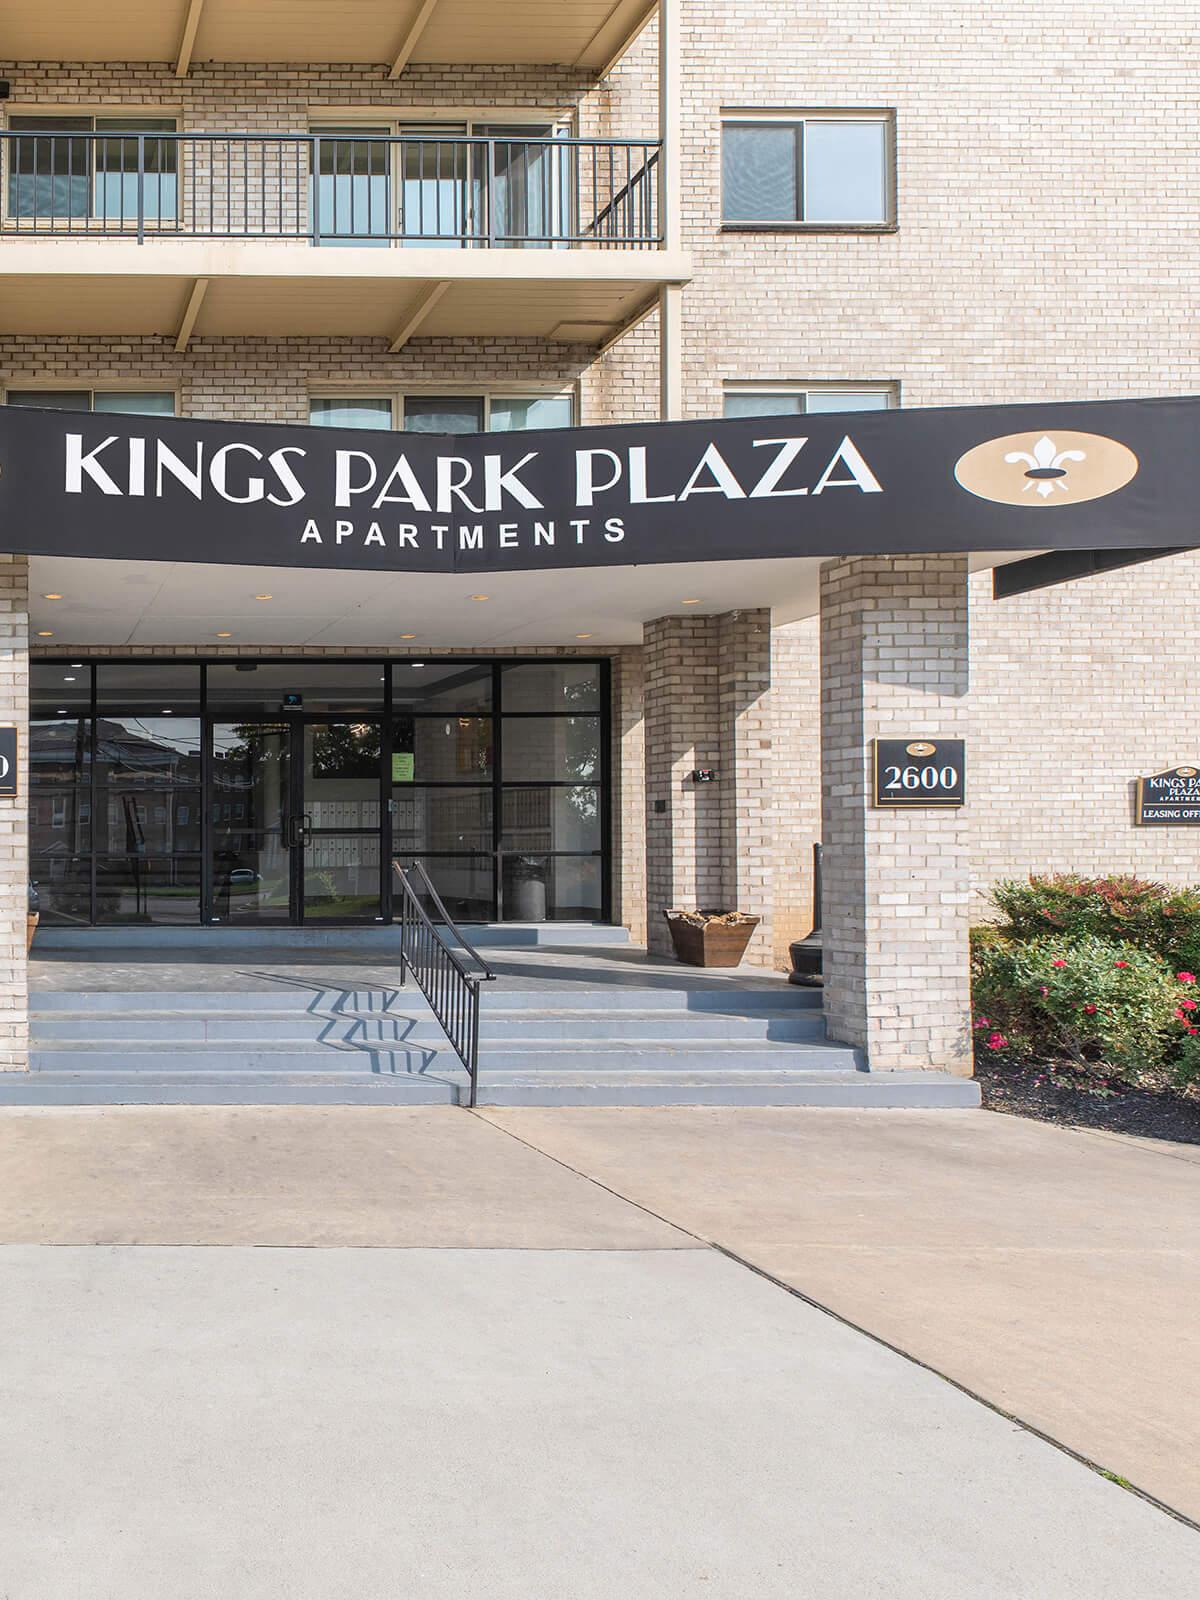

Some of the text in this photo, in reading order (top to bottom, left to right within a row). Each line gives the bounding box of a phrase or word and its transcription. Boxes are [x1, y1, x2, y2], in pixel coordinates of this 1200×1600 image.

[65, 433, 884, 514] KINGS PARK PLAZA
[300, 517, 625, 550] APARTMENTS
[884, 766, 958, 790] 2600
[1150, 778, 1186, 788] KINGS
[1143, 810, 1181, 818] LEASING
